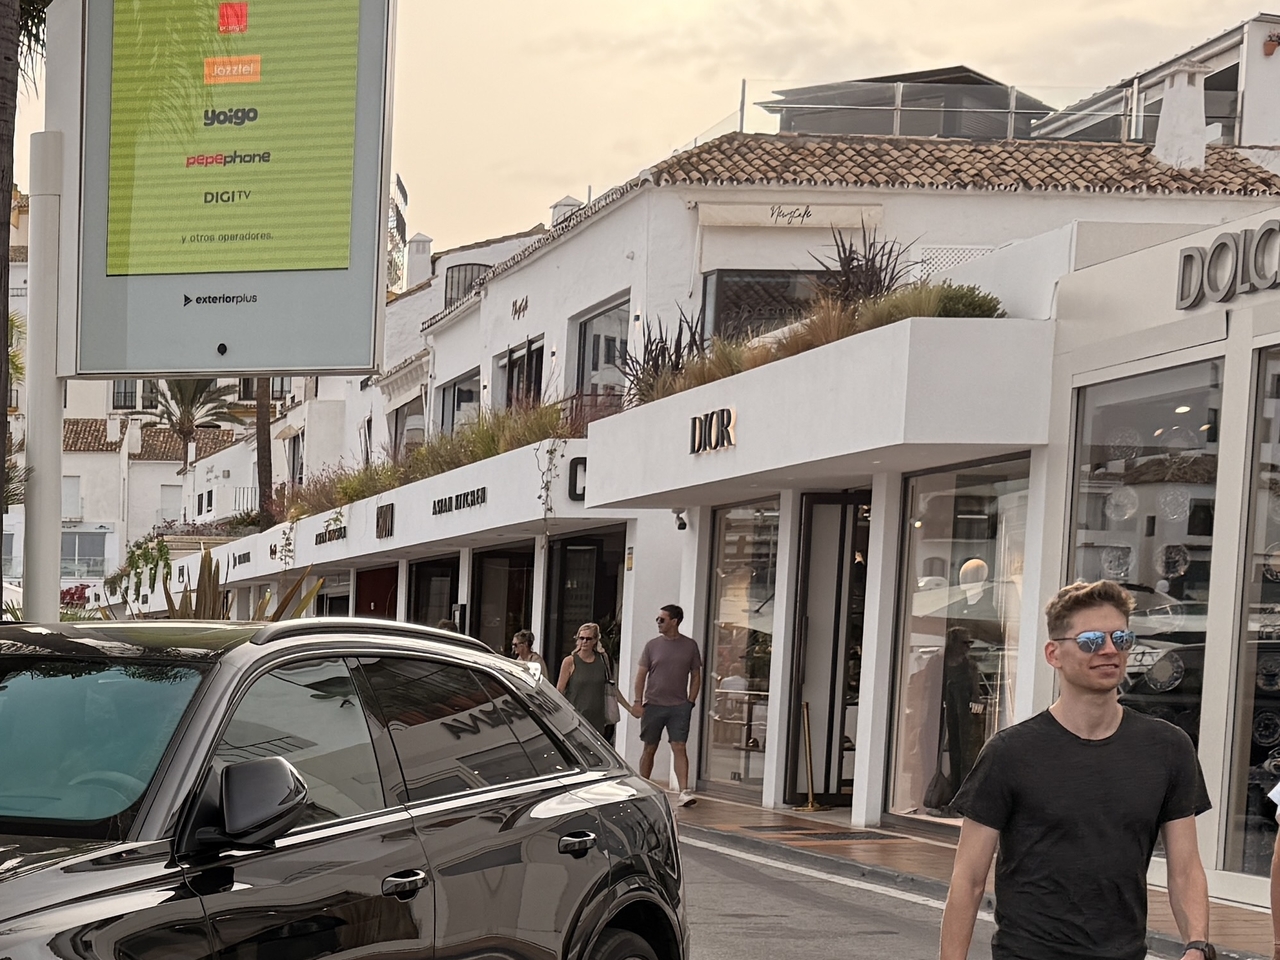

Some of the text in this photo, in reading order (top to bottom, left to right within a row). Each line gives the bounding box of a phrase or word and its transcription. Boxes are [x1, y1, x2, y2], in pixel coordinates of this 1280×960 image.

[203, 107, 258, 126] yoigo
[185, 150, 271, 168] pepephone
[181, 235, 187, 244] y
[1176, 218, 1280, 310] DOLC
[195, 293, 258, 305] exteriorplus
[689, 408, 733, 455] DIOR
